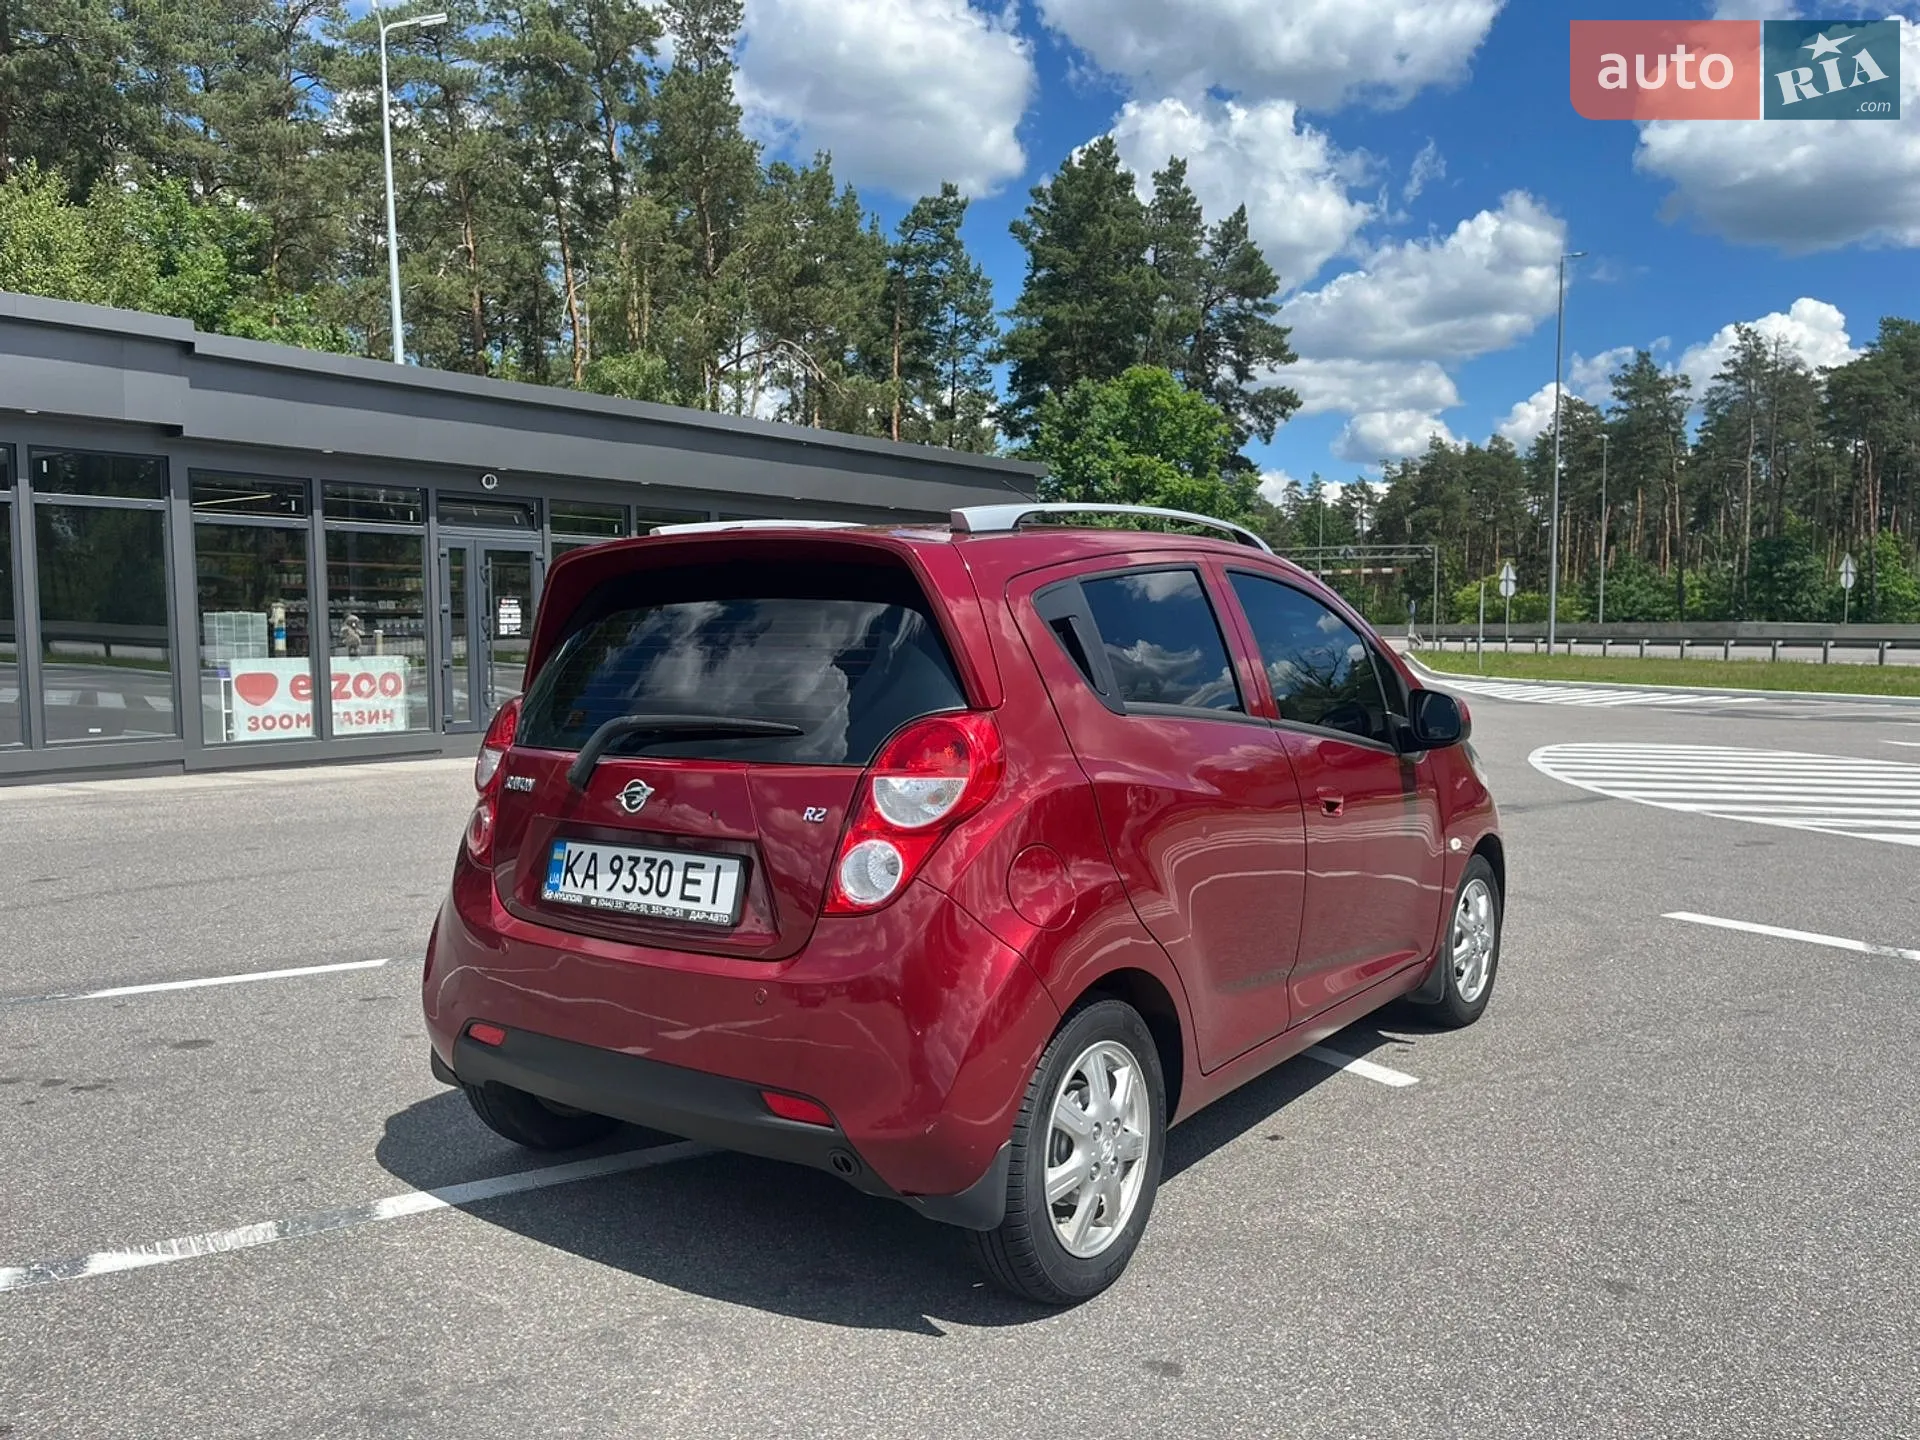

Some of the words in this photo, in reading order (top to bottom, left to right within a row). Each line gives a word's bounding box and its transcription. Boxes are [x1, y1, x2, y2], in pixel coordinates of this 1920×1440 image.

[803, 806, 828, 822] R2
[562, 849, 599, 891] KA
[606, 854, 674, 898] 9330
[679, 861, 722, 905] EI
